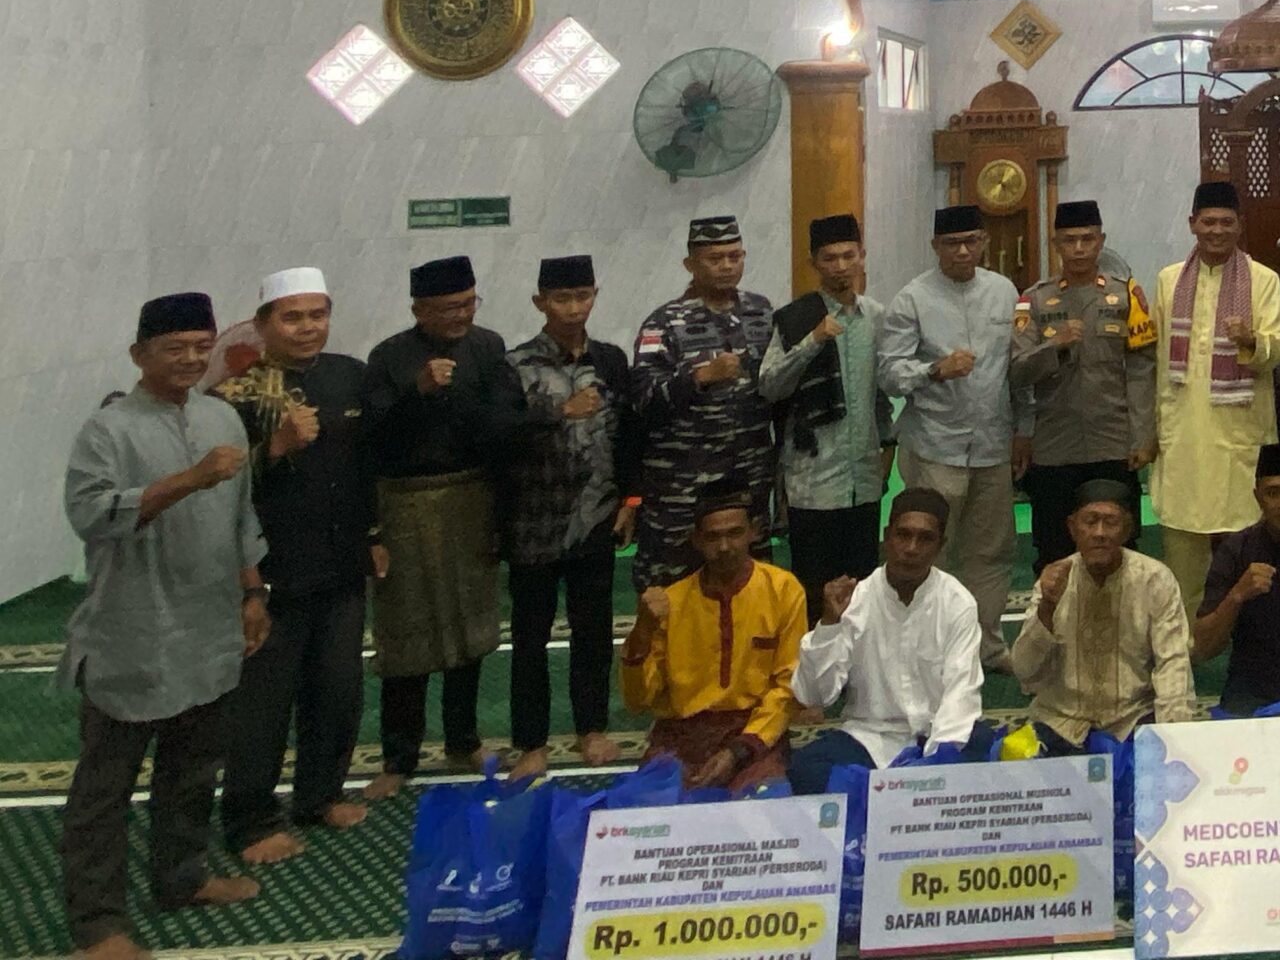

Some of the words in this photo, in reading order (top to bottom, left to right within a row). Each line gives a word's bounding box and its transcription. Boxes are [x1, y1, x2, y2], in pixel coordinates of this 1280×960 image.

[912, 795, 957, 807] BANTUAN
[960, 790, 1024, 803] OPERASIONAL
[1026, 787, 1071, 799] MUSHOLA
[941, 806, 987, 817] PROGRAM
[988, 803, 1043, 814] KEMITRAAN
[905, 823, 931, 833] BANK
[934, 821, 956, 831] RIAU
[959, 819, 987, 829] KEPRI
[989, 816, 1029, 828] SYARIAH
[982, 831, 1001, 841] DAN
[634, 846, 684, 860] BANTUAN
[686, 841, 757, 856] OPERASIONAL
[761, 838, 800, 850] MASJID
[878, 849, 938, 861] PEMERINTAH
[941, 844, 997, 857] KABUPATEN
[999, 841, 1056, 853] KEPULAUAN
[1058, 837, 1104, 848] ANAMBAS
[1184, 849, 1251, 869] SAFARI
[658, 857, 709, 870] PROGRAM
[712, 852, 773, 866] KEMITRAAN
[618, 873, 647, 885] BANK
[649, 871, 675, 882] RIAU
[678, 869, 709, 881] KEPRI
[712, 866, 757, 879] SYARIAH
[759, 860, 827, 877] (PERSERODA)
[912, 872, 949, 900] Rp.
[957, 864, 1067, 892] 500.000,-
[702, 880, 724, 891] DAN
[585, 895, 651, 912] PEMERINTAH
[656, 892, 717, 906] KABUPATEN
[720, 887, 784, 901] KEPULAUAN
[786, 884, 836, 897] ANAMBAS
[885, 911, 941, 931] SAFARI
[946, 905, 1035, 927] RAMADHAN
[1039, 903, 1076, 920] 1446
[1081, 900, 1092, 917] H
[594, 925, 641, 955] Rp.
[653, 911, 818, 946] 1.000.000,-
